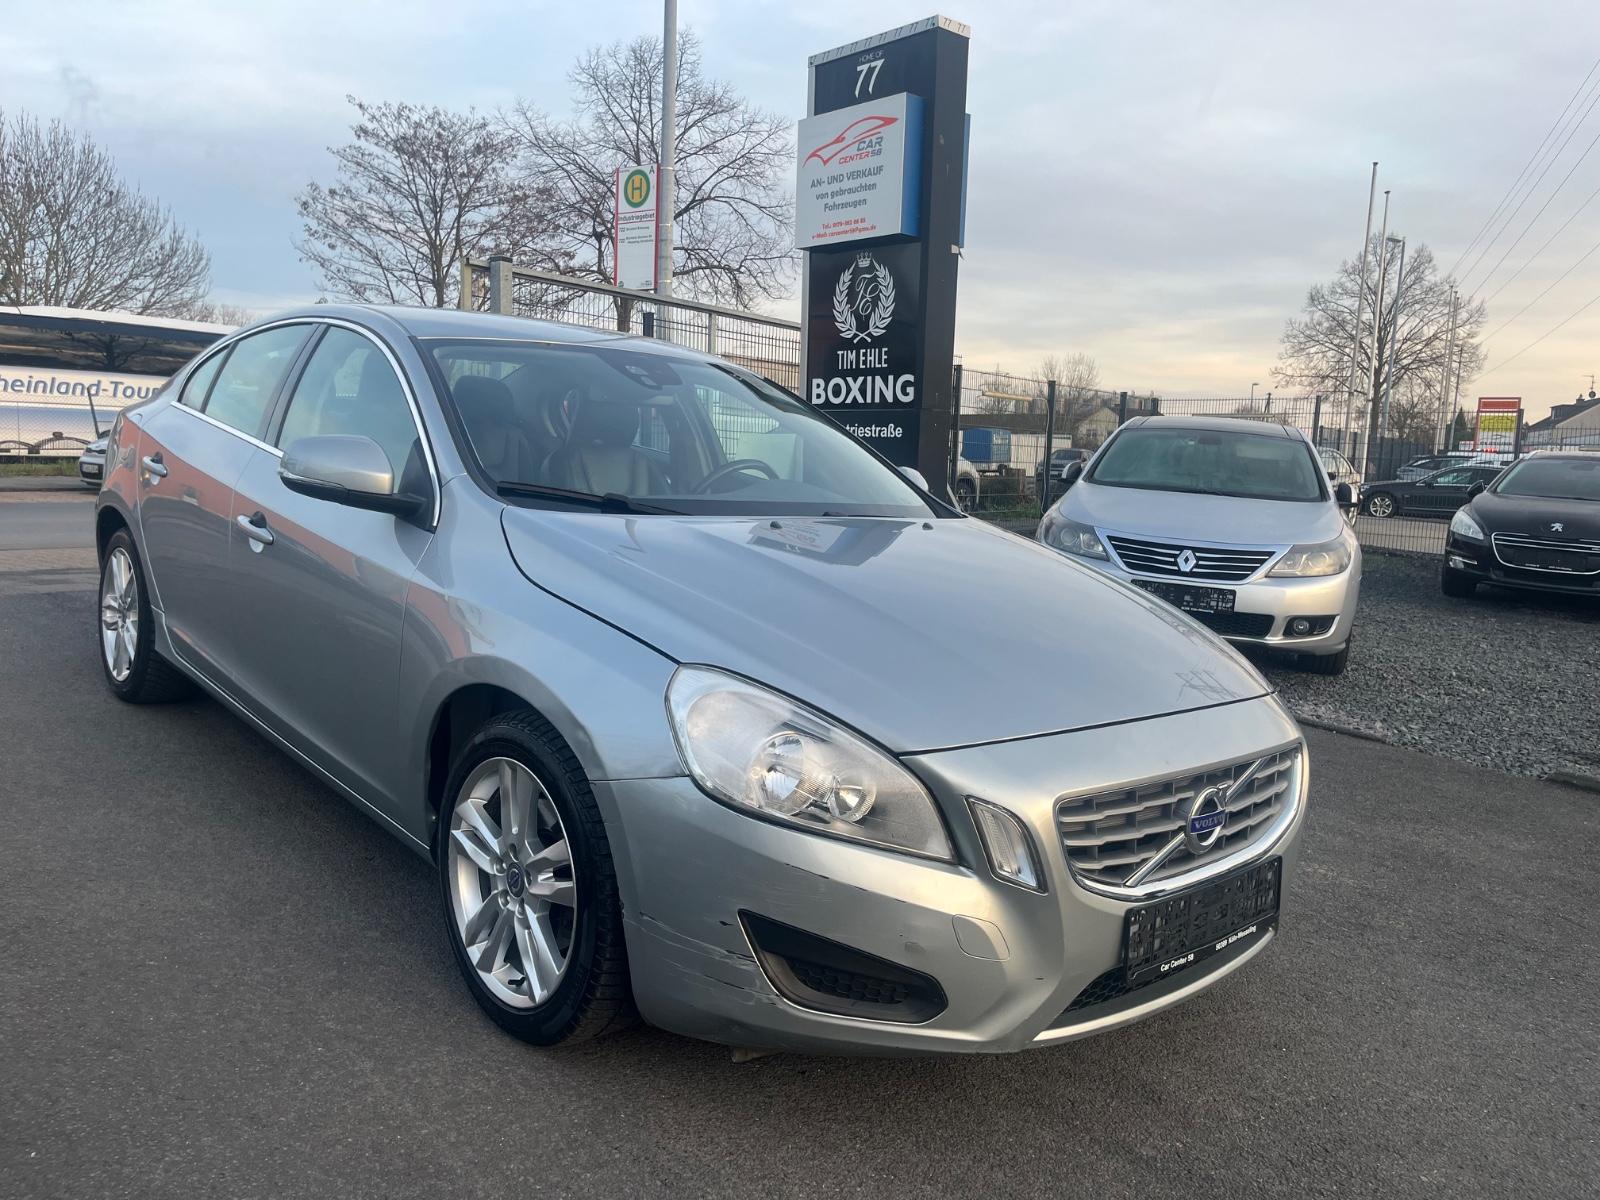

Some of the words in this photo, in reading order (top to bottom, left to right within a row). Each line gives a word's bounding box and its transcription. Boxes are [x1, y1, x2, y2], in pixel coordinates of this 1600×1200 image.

[943, 17, 952, 27] 77
[957, 22, 966, 32] 77
[854, 58, 886, 99] 77
[857, 136, 884, 152] CAR
[810, 178, 826, 189] AN-
[827, 174, 844, 185] UND
[846, 165, 884, 181] VERKAUF
[631, 178, 643, 200] H
[815, 191, 829, 201] von
[830, 182, 877, 200] gebrauchten
[824, 198, 867, 213] Fahrzeugen
[837, 349, 856, 370] TIM
[860, 347, 888, 369] EHLE
[811, 373, 915, 405] BOXING
[1160, 963, 1170, 972] Car
[1170, 957, 1187, 968] Center
